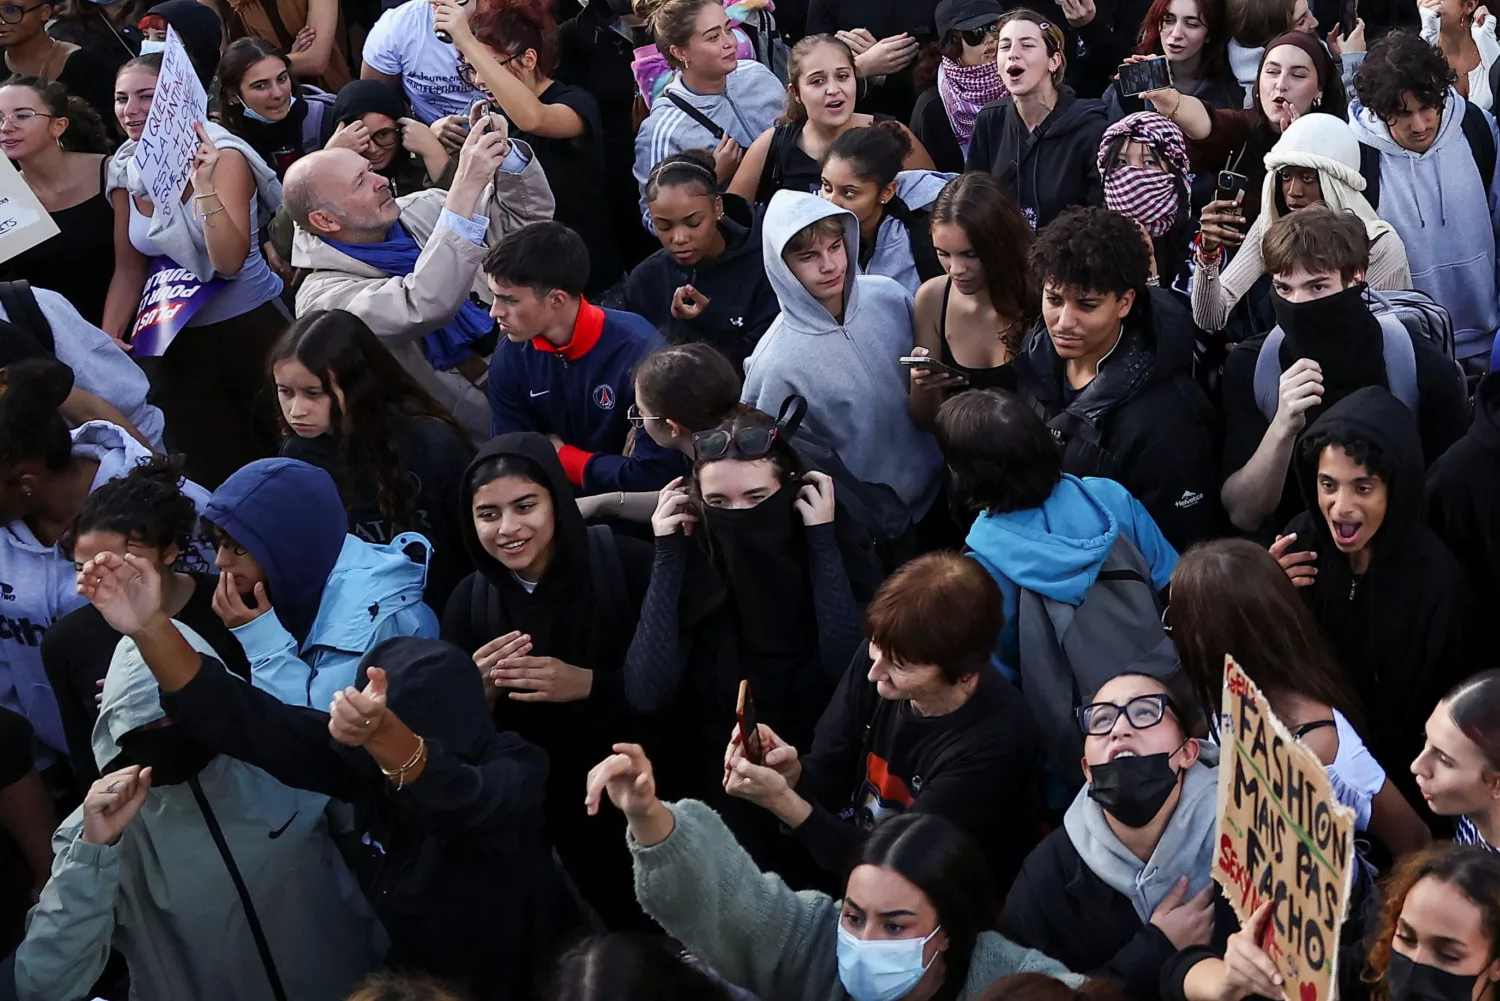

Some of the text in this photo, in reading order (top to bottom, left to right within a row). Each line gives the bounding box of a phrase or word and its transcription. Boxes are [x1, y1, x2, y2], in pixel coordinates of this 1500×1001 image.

[135, 79, 172, 170] LA QUEUE
[152, 135, 171, 198] EST LA
[140, 304, 183, 331] PLUS
[148, 284, 201, 305] POUR
[1238, 693, 1348, 871] FASHION
[1233, 751, 1287, 865] MAIS
[1296, 841, 1340, 934] PAS
[1246, 826, 1327, 972] FACHO
